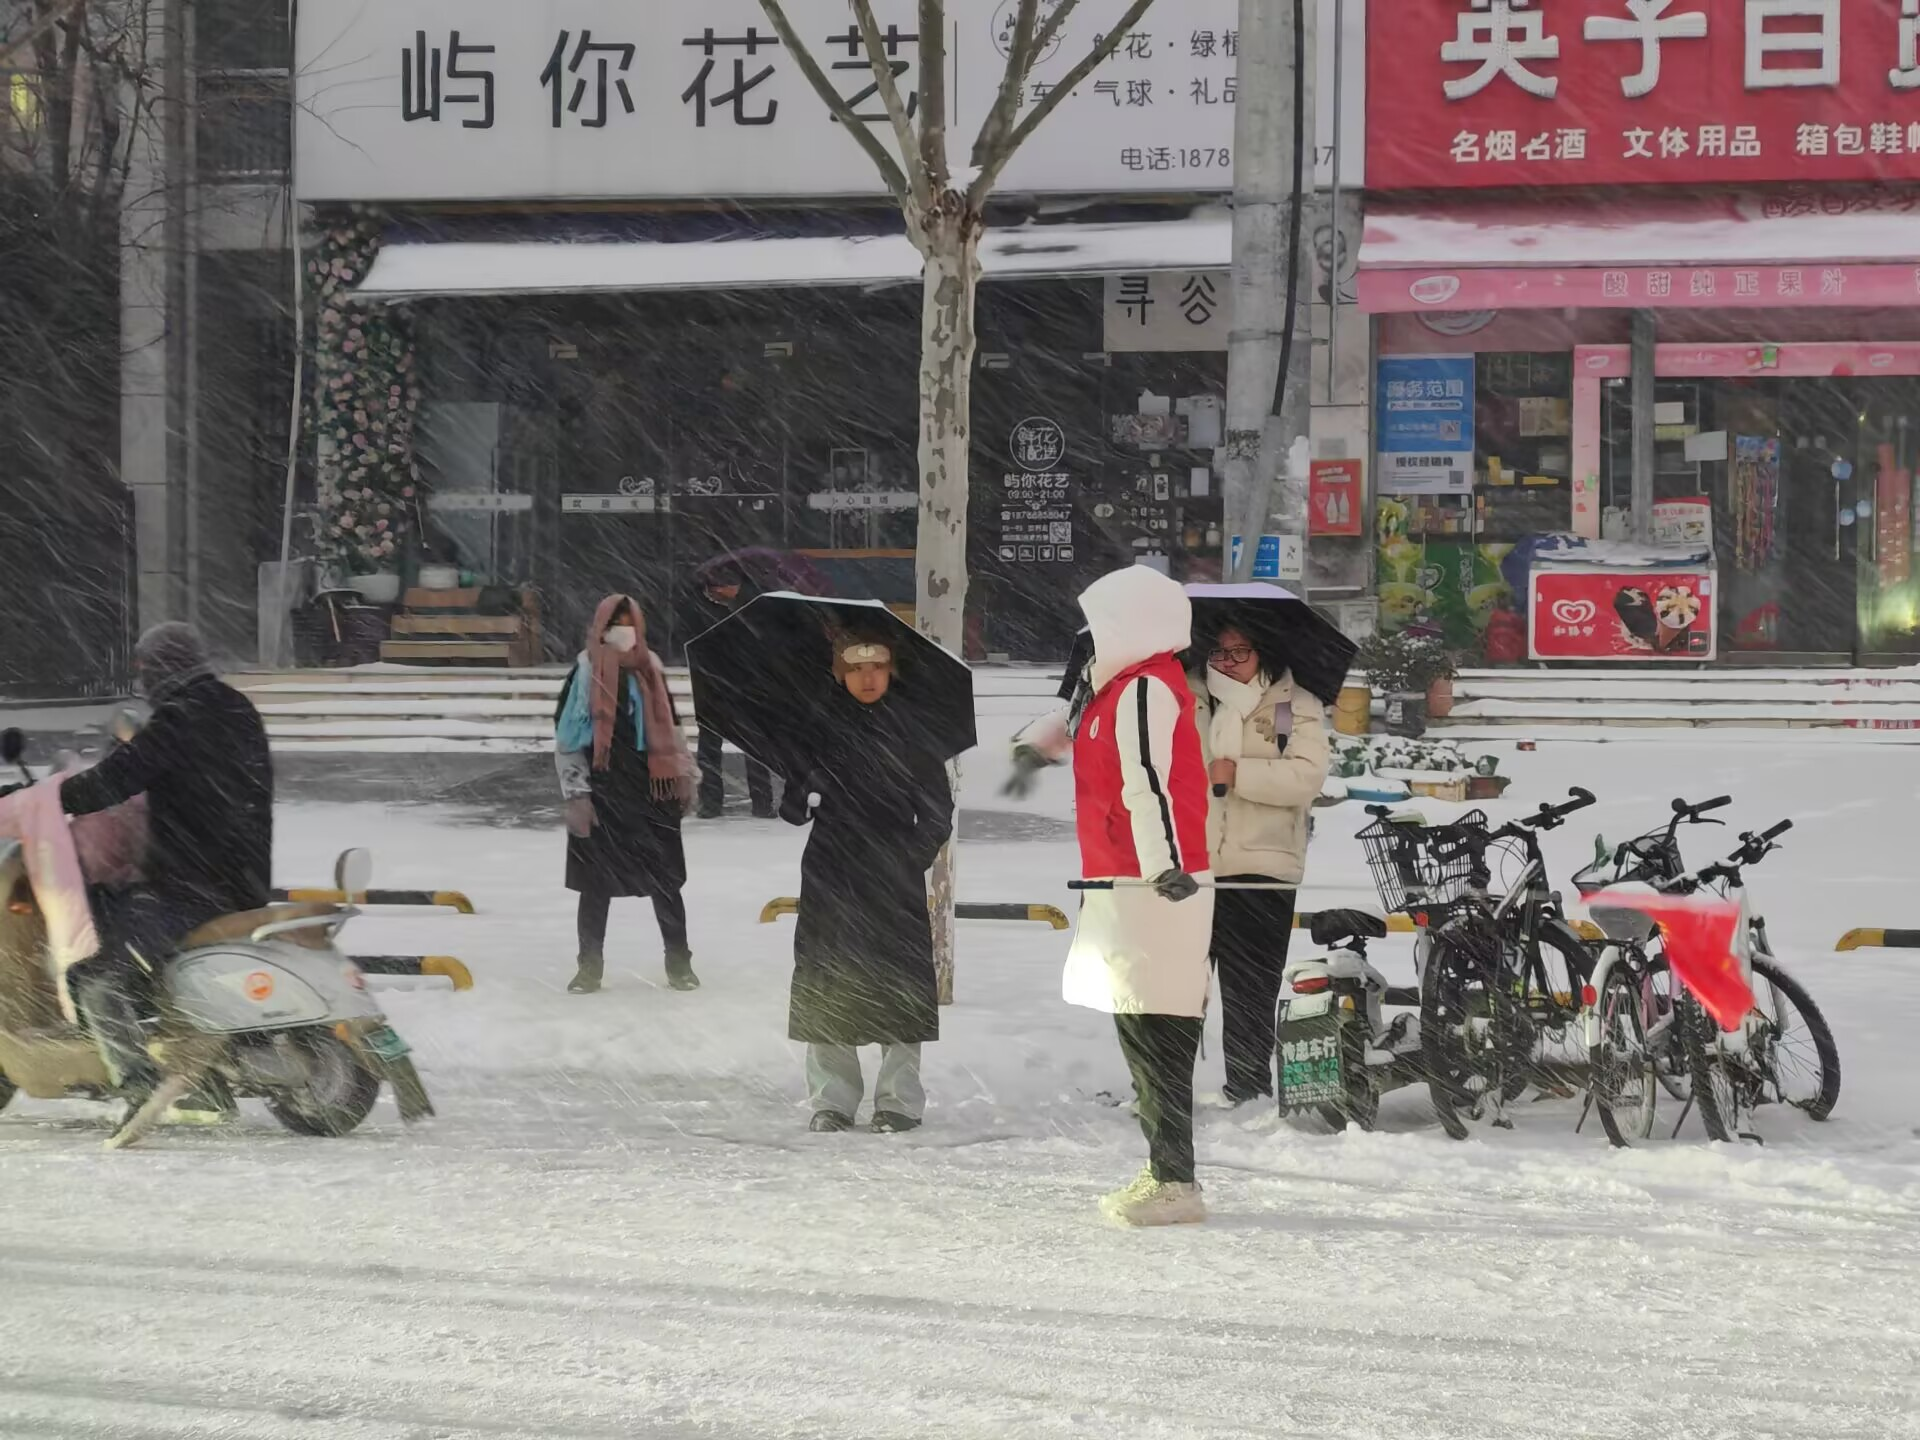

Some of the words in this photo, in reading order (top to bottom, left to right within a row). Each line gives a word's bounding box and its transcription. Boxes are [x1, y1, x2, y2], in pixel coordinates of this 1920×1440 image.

[401, 29, 919, 128] 屿你花艺
[1441, 0, 1920, 99] 英子百
[1449, 128, 1586, 163] 名烟名酒
[1622, 125, 1762, 159] 文体用品
[1004, 472, 1070, 488] 屿你花艺
